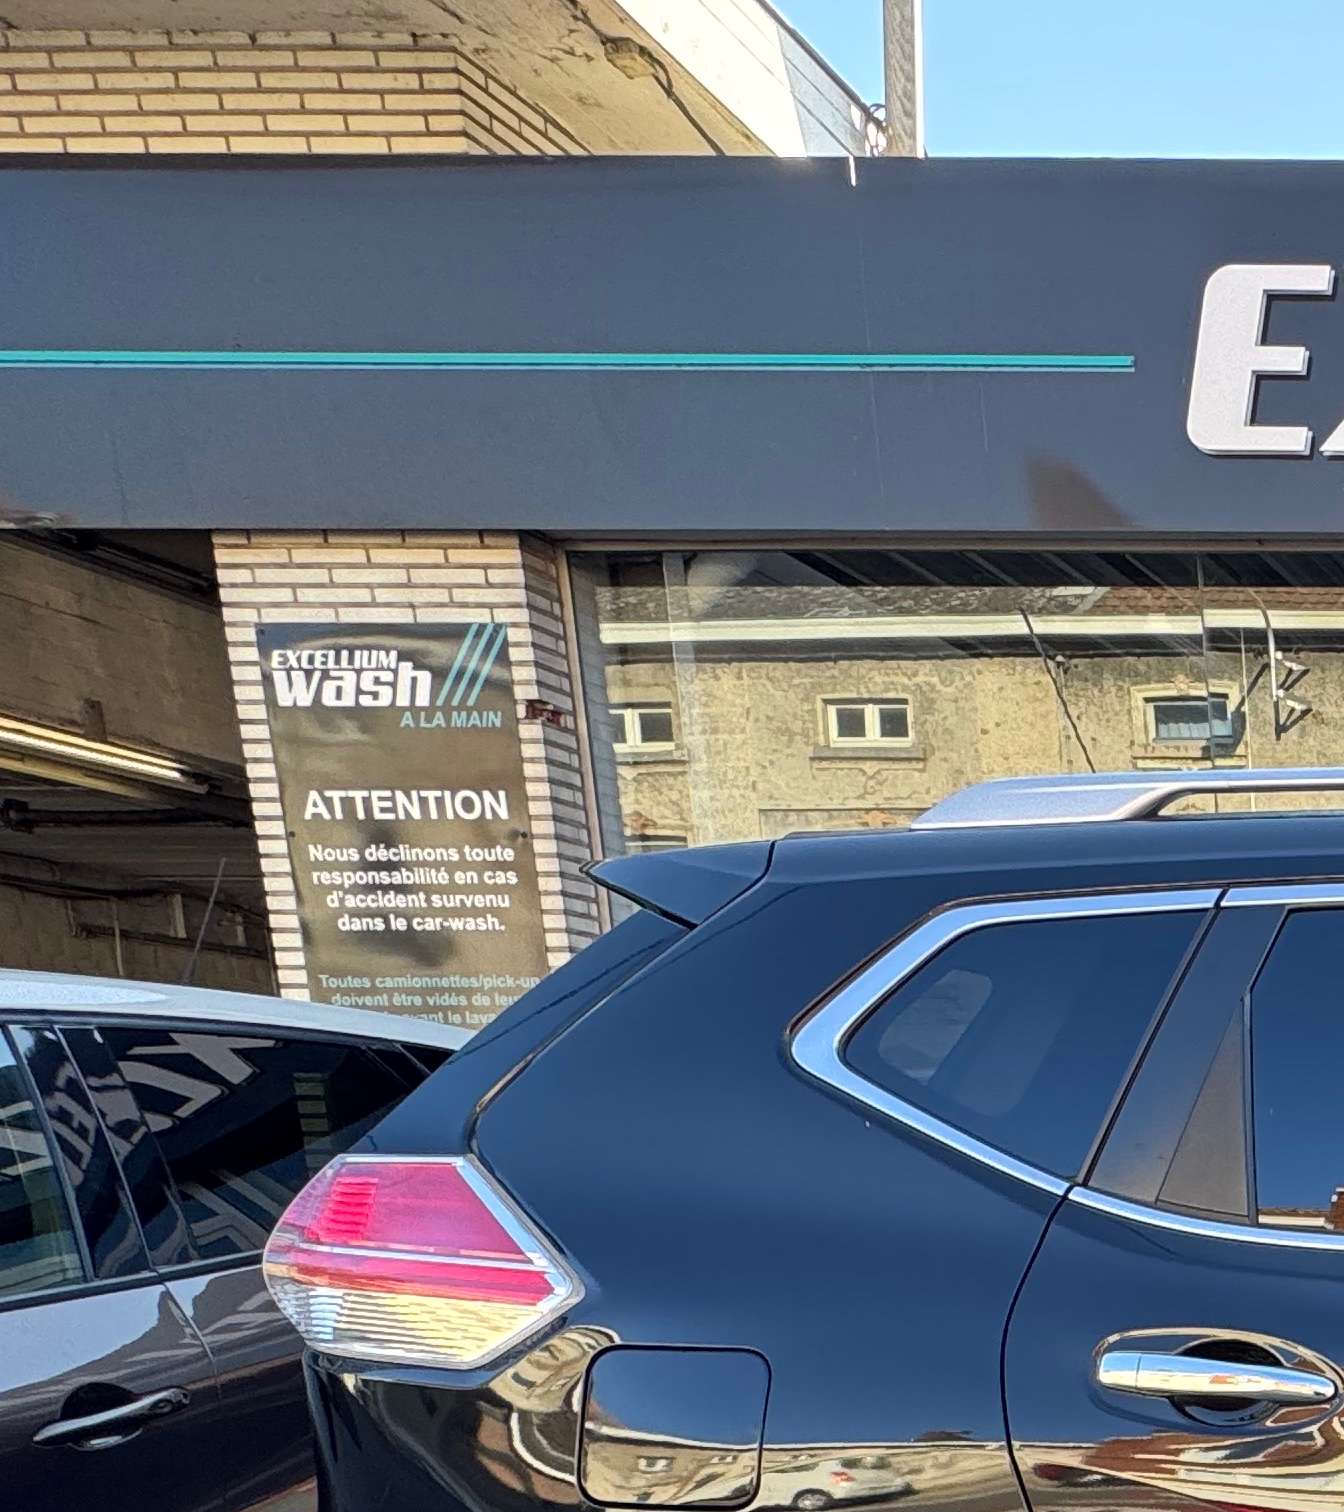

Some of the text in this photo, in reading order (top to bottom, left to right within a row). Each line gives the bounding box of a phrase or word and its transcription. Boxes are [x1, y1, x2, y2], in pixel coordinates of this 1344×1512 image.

[271, 649, 398, 670] EXCELLIUM
[272, 661, 432, 708] wash
[400, 711, 501, 728] A LA MAIN
[304, 789, 510, 821] ATTENTION
[308, 843, 515, 863] Nous déclinons toute
[312, 867, 519, 889] responsabilité en cas
[326, 890, 511, 909] d'accident survenu
[337, 914, 506, 932] dans le car-wash.
[318, 974, 371, 988] Toutes
[331, 992, 522, 1007] doivent être vidés de leu
